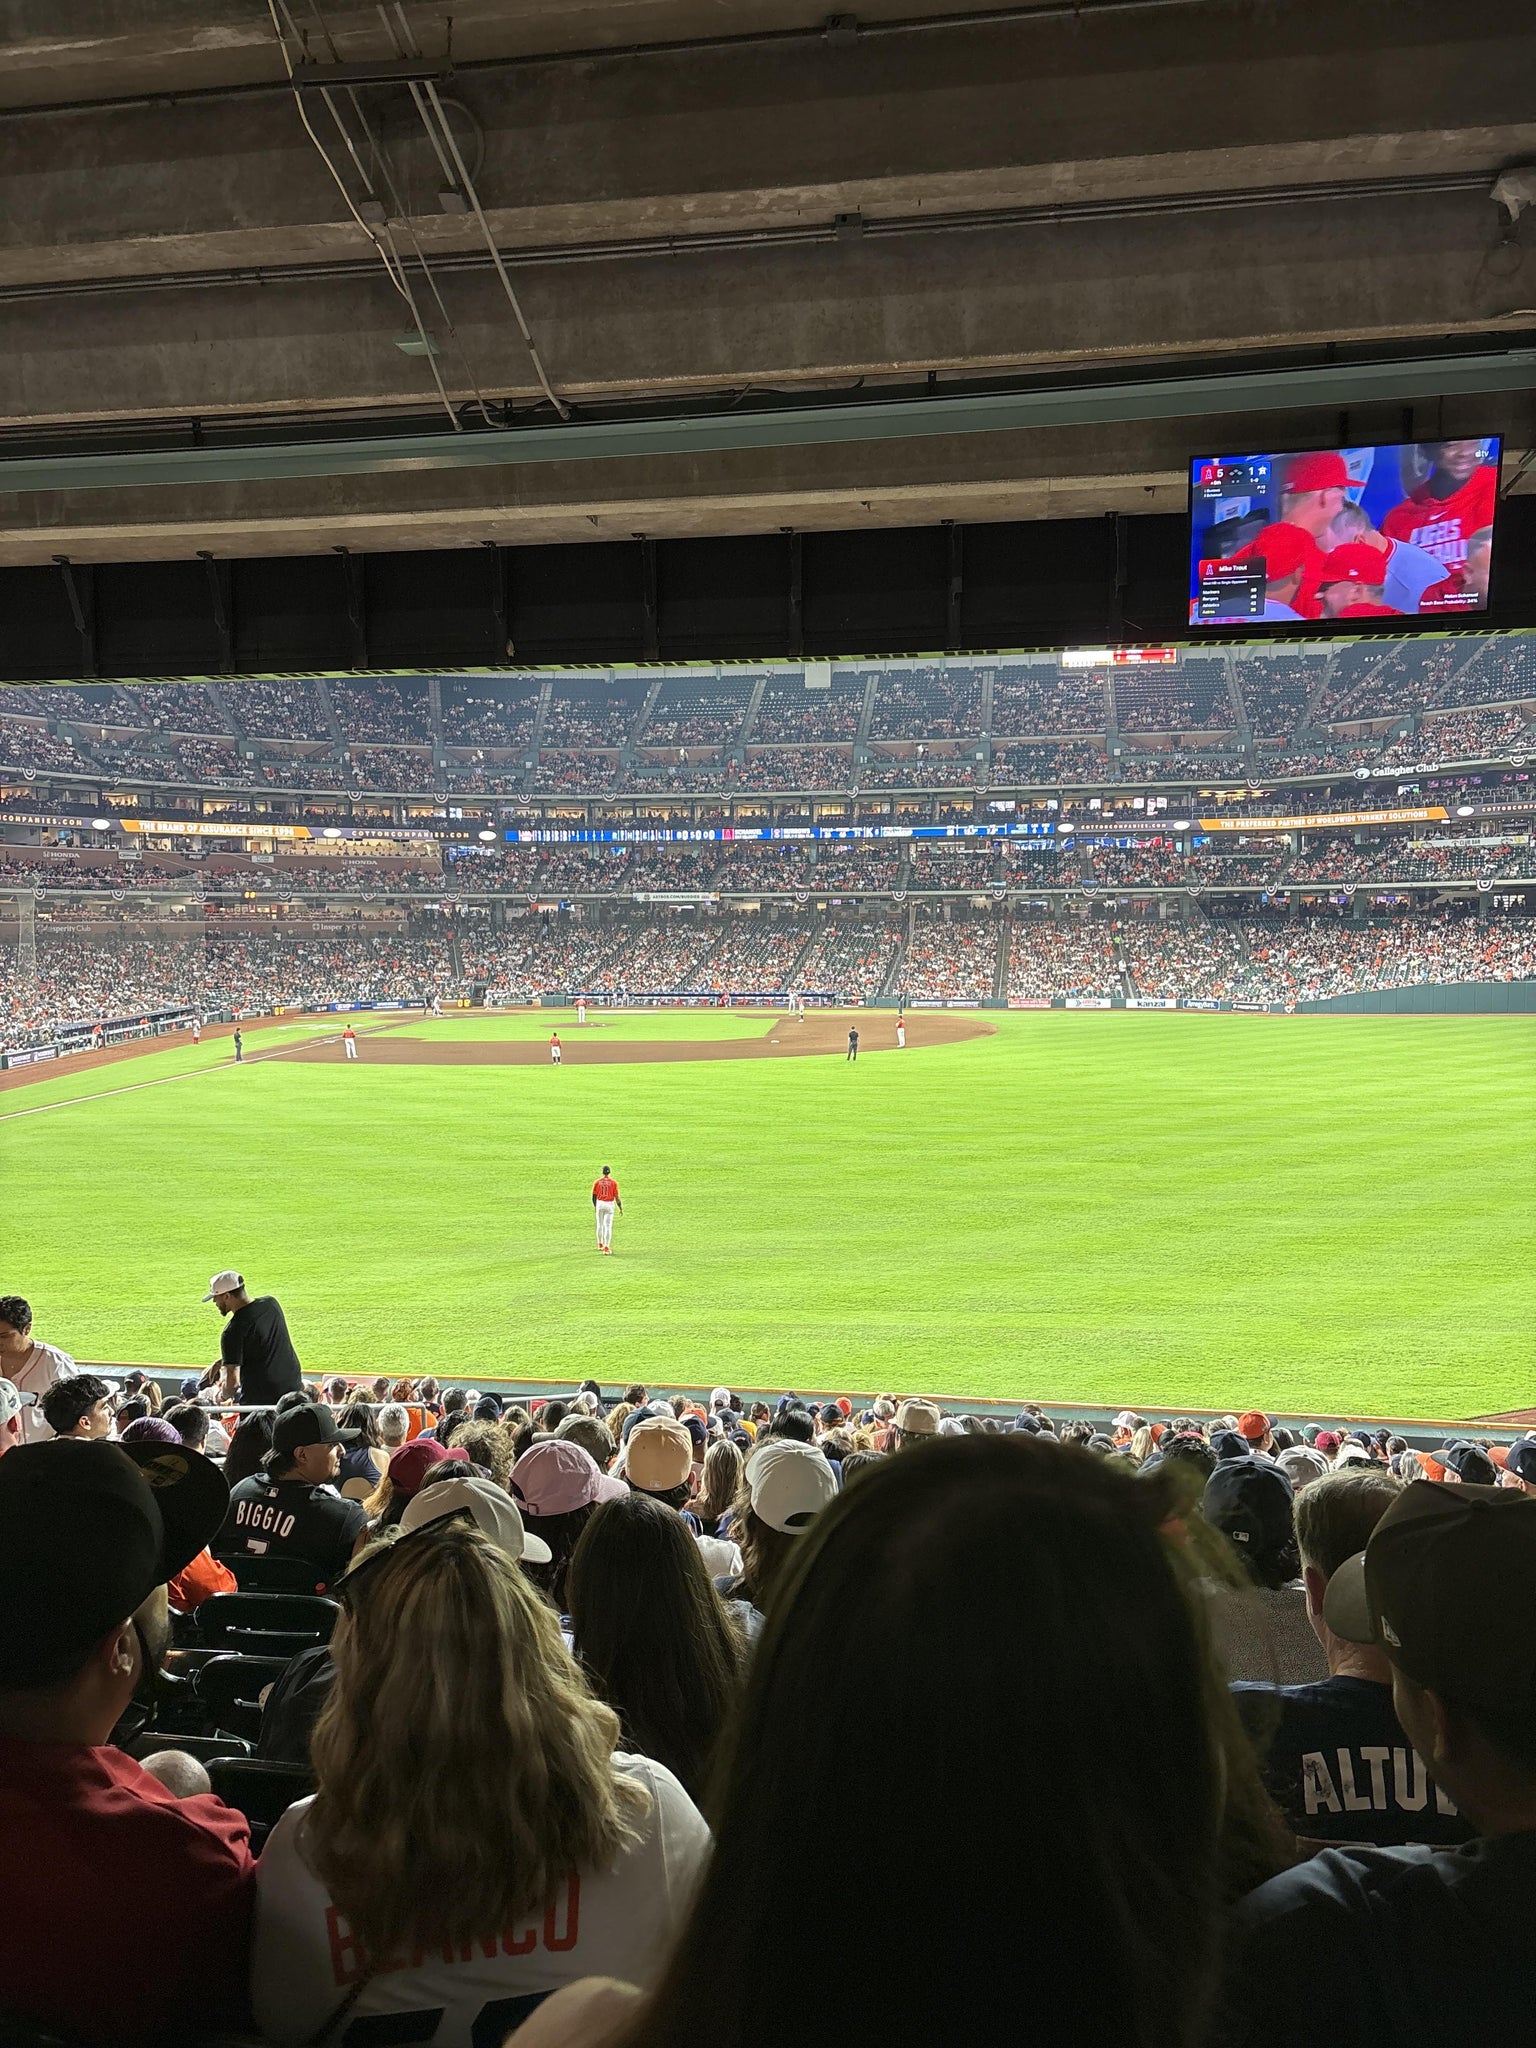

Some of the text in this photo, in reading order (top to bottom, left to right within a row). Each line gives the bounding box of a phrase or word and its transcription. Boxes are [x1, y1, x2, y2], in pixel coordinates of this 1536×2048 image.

[1249, 467, 1254, 476] 1
[1372, 764, 1415, 777] Gallagher
[1416, 762, 1439, 773] Club
[1220, 820, 1235, 828] THE
[1235, 819, 1276, 828] PREFERRED
[1278, 818, 1306, 827] PARTNER
[1317, 815, 1356, 825] WORLDWIDE
[1389, 810, 1428, 820] SOLUTIONS
[138, 821, 155, 831] THE
[157, 822, 185, 832] BRAND
[186, 823, 198, 833] OF
[199, 824, 247, 834] ASSURANCE
[249, 826, 273, 836] SINCE
[351, 830, 470, 839] COTTONCOMPANIES.COM
[50, 851, 80, 859] HONDA
[235, 1500, 296, 1538] BIGGIO
[325, 1866, 580, 1988] BACO
